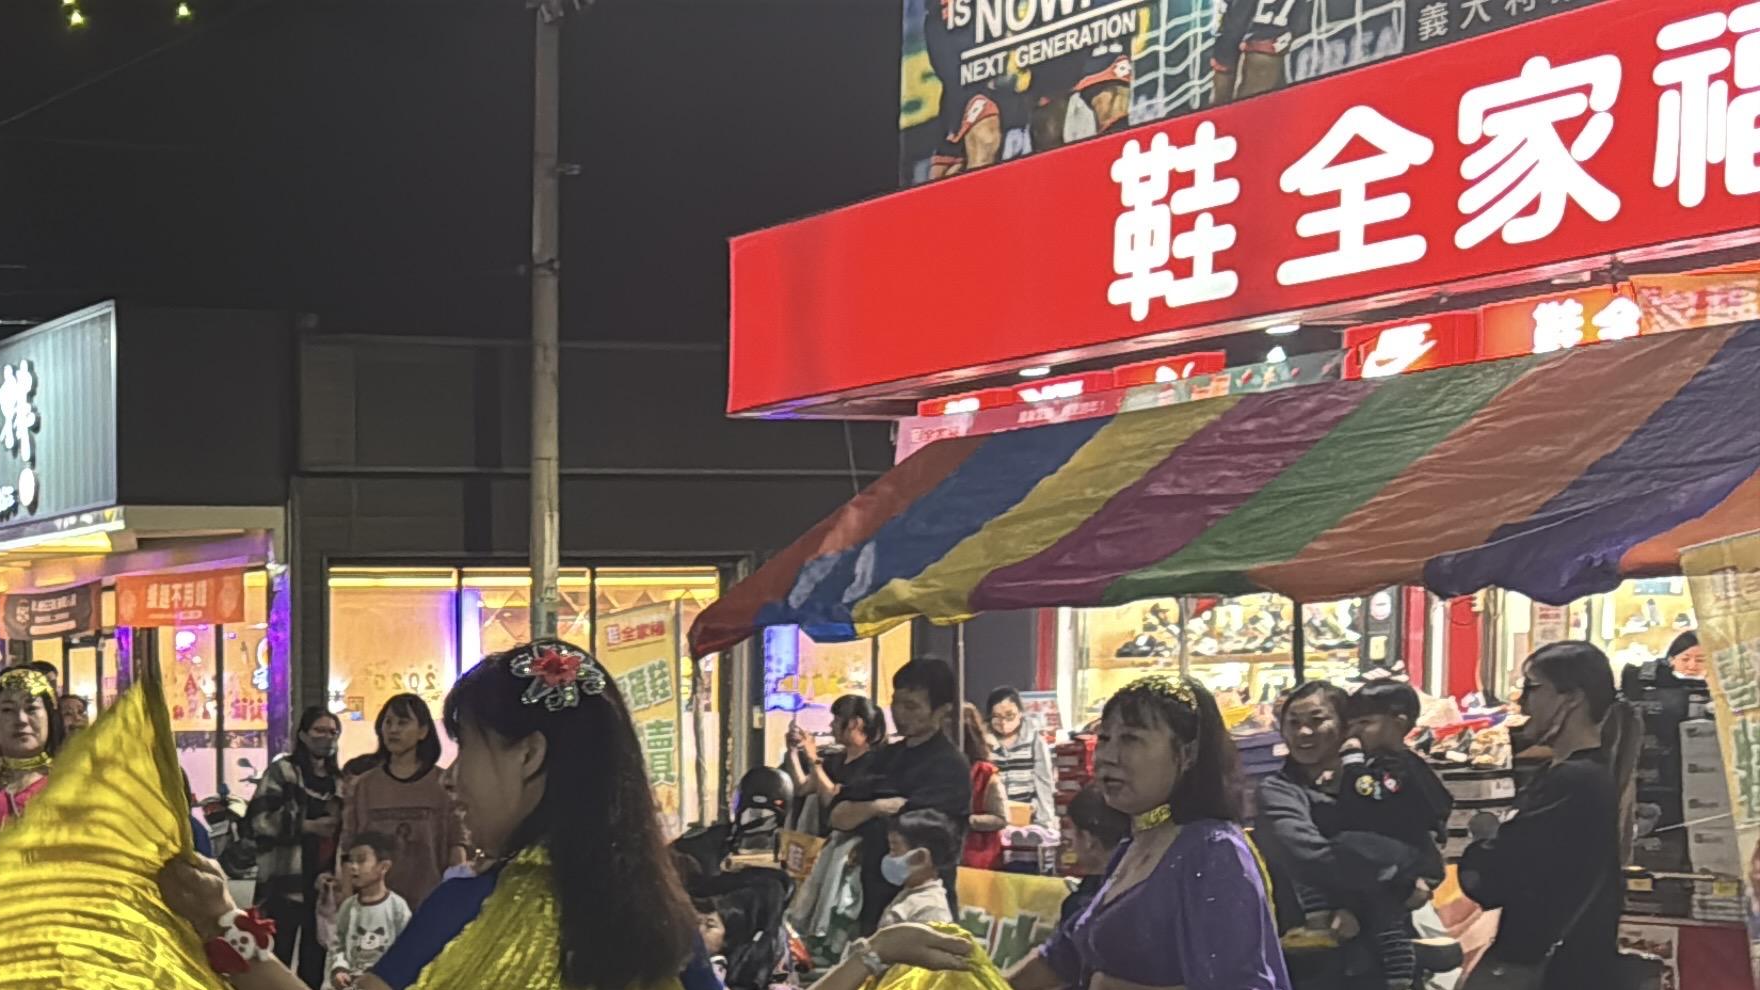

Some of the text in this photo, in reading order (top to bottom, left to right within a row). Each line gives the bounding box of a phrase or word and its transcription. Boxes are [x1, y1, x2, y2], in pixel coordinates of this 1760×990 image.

[960, 9, 1138, 86] NEXT GENERATION
[1107, 2, 1760, 322] 鞋全家福
